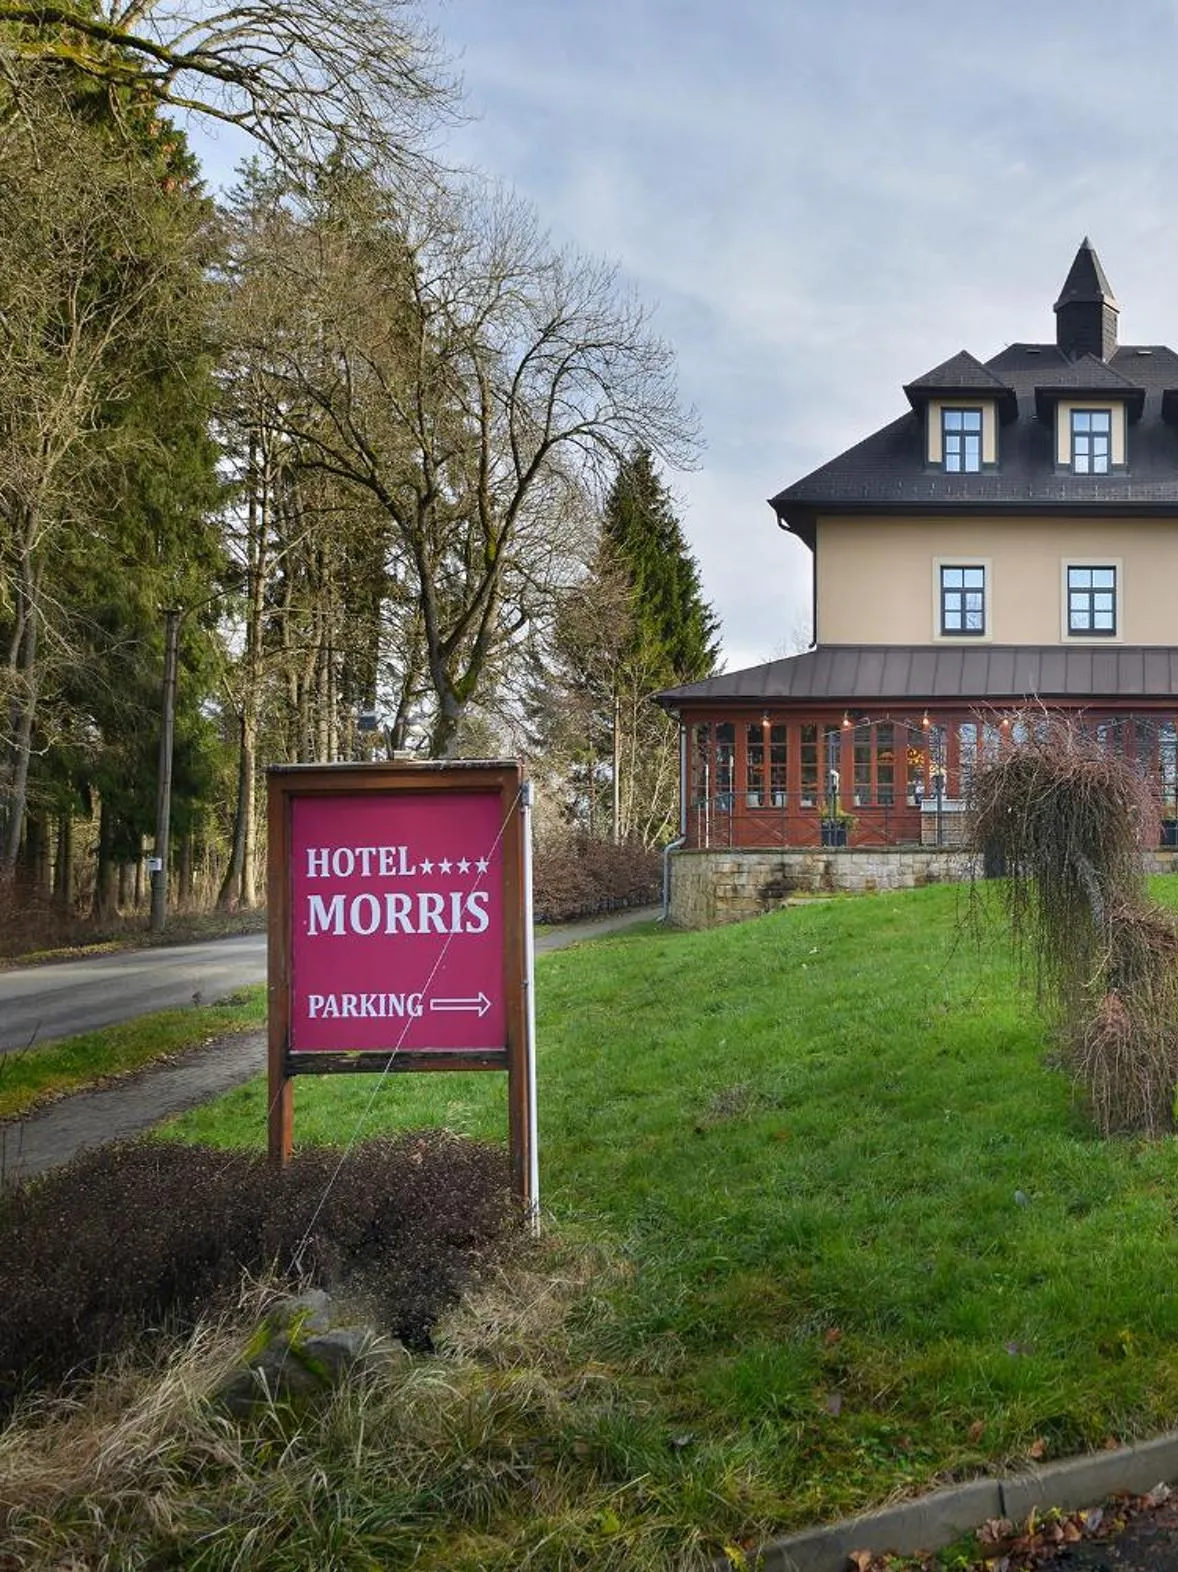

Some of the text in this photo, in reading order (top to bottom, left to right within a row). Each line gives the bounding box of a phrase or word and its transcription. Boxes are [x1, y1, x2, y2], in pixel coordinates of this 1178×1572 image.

[306, 846, 417, 878] HOTEL
[307, 891, 490, 936] MORRIS
[308, 993, 423, 1018] PARKING
